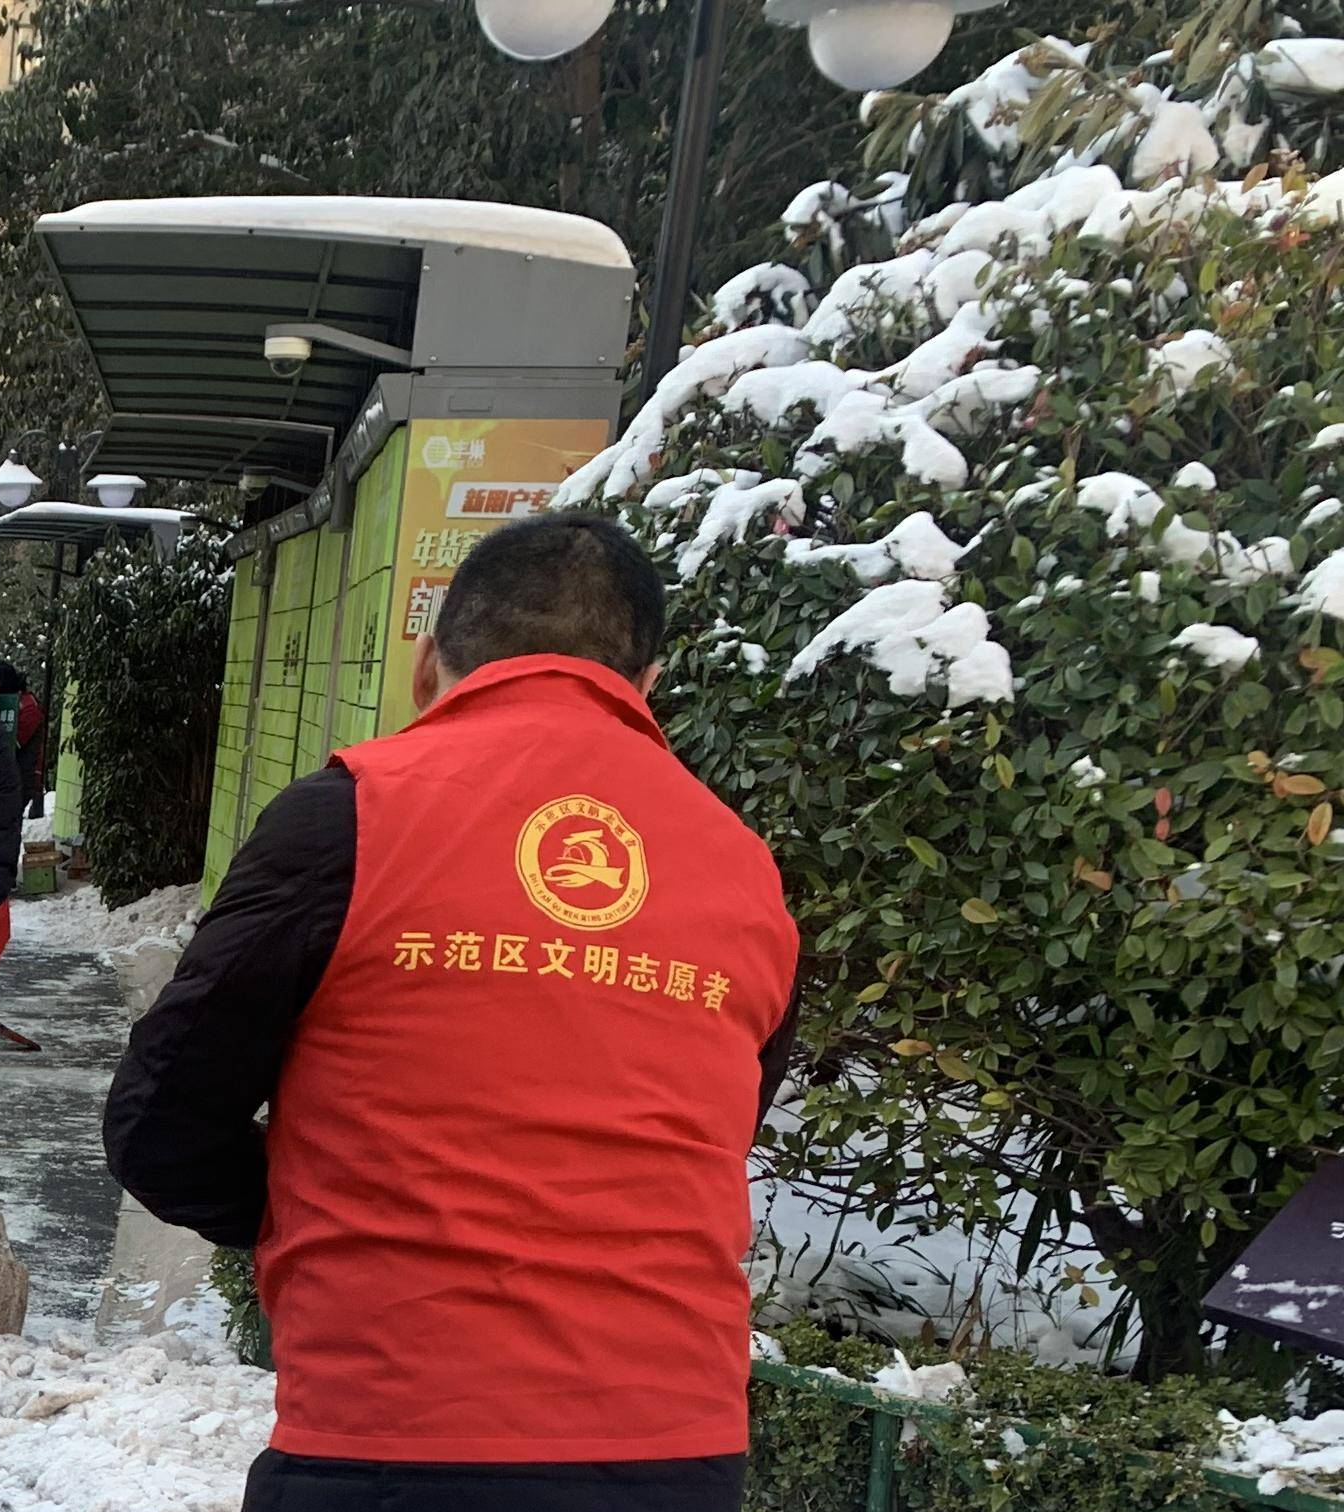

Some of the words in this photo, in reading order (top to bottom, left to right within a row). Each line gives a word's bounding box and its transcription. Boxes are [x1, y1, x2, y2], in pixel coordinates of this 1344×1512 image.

[534, 801, 637, 848] 示范区文明志愿者
[393, 931, 732, 1013] 示范区文明志愿者
